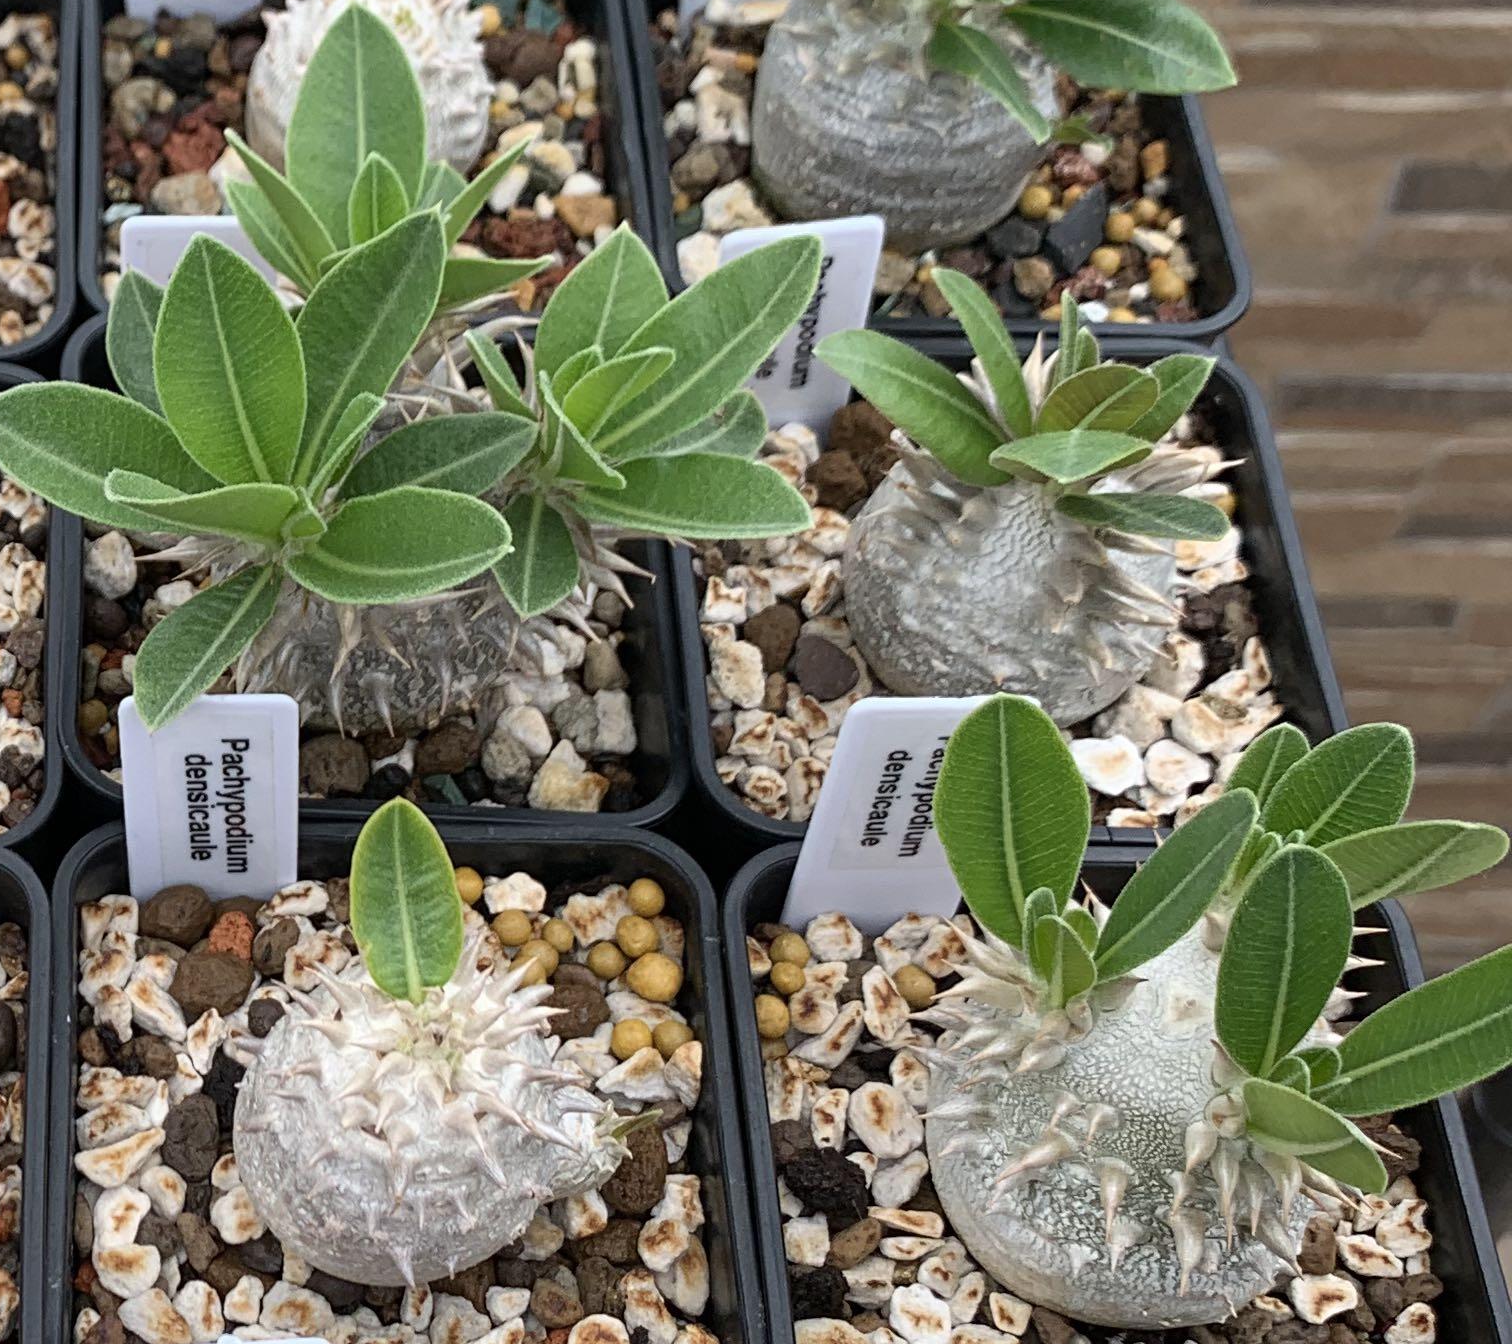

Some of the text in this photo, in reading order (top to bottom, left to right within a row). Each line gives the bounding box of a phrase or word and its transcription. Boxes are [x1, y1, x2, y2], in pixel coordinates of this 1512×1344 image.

[184, 754, 218, 861] densicaule
[216, 738, 253, 873] Pachypodium
[861, 750, 912, 846] densicaule
